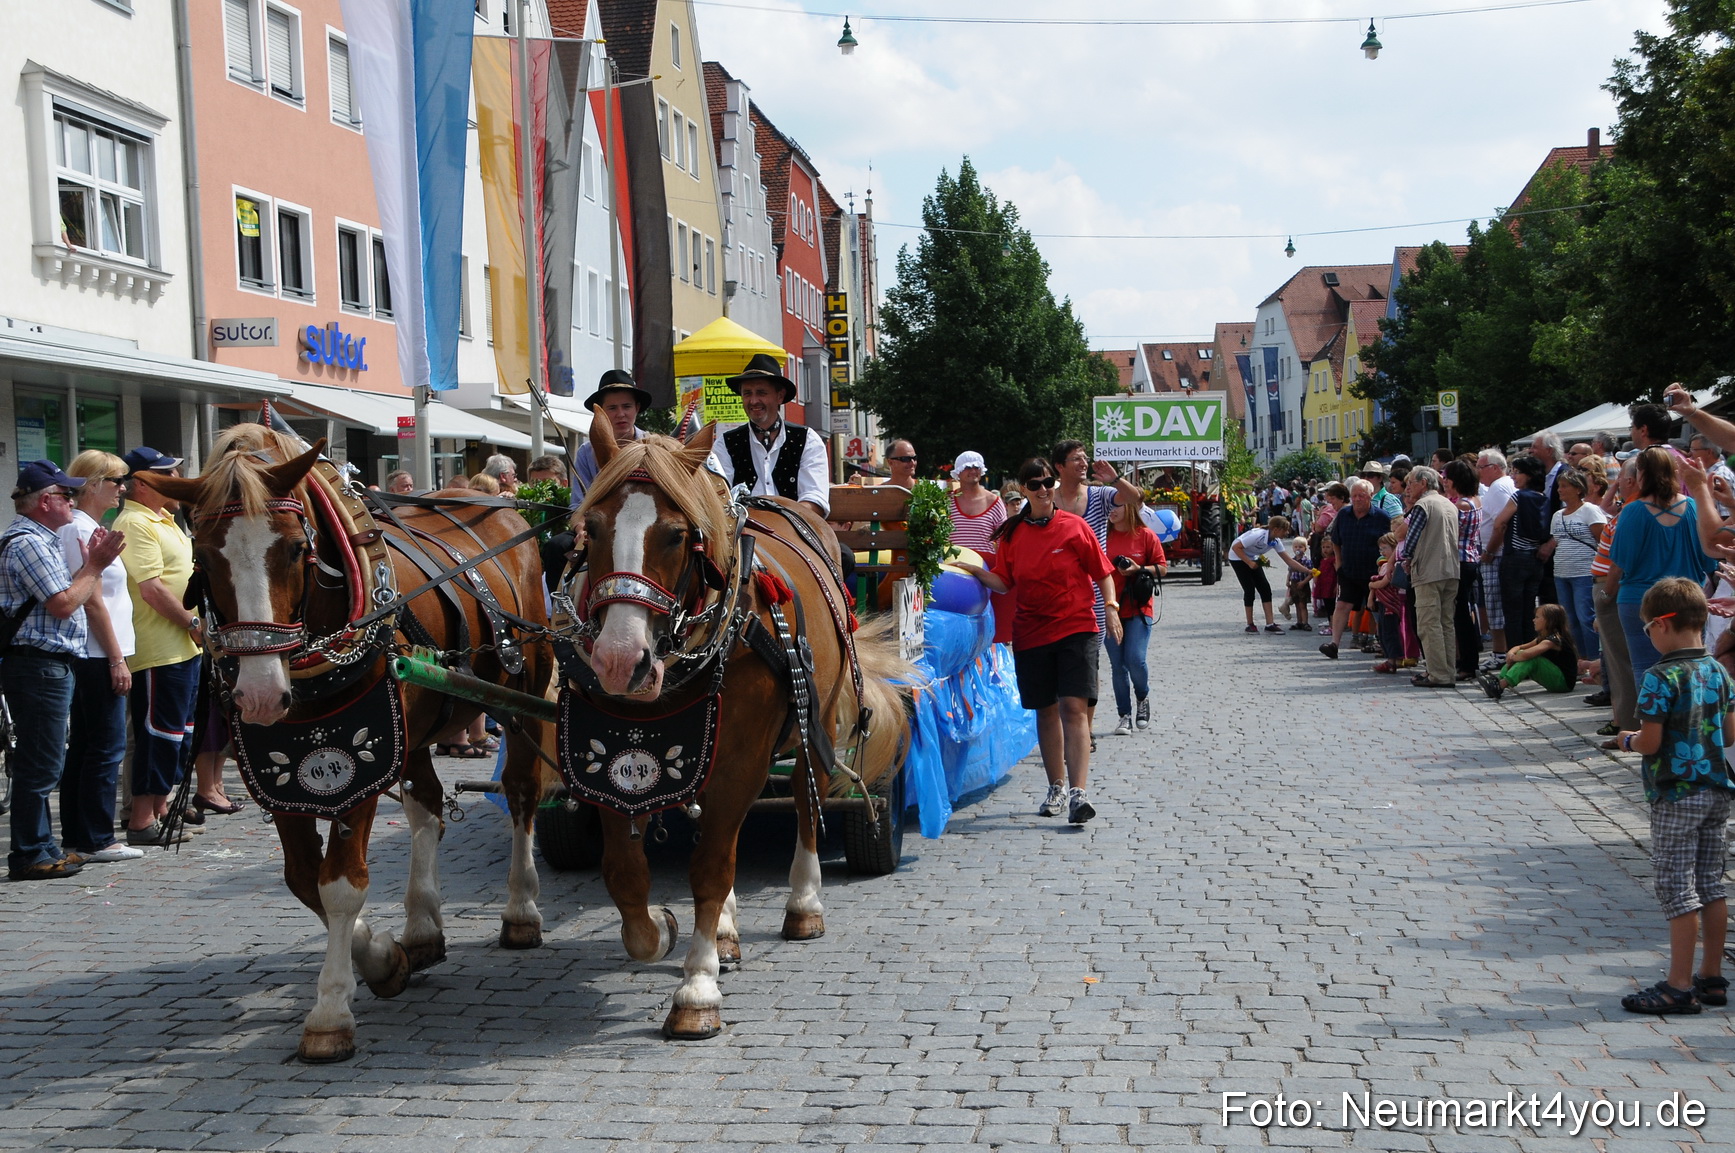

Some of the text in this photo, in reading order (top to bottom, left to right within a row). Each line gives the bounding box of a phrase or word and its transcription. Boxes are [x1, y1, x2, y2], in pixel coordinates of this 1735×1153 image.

[213, 322, 273, 341] sutor.
[826, 294, 849, 408] HOTEL
[706, 378, 722, 386] New
[1134, 405, 1217, 437] DAV
[1095, 446, 1222, 457] Sektion Neumarkt i.d. OPf.
